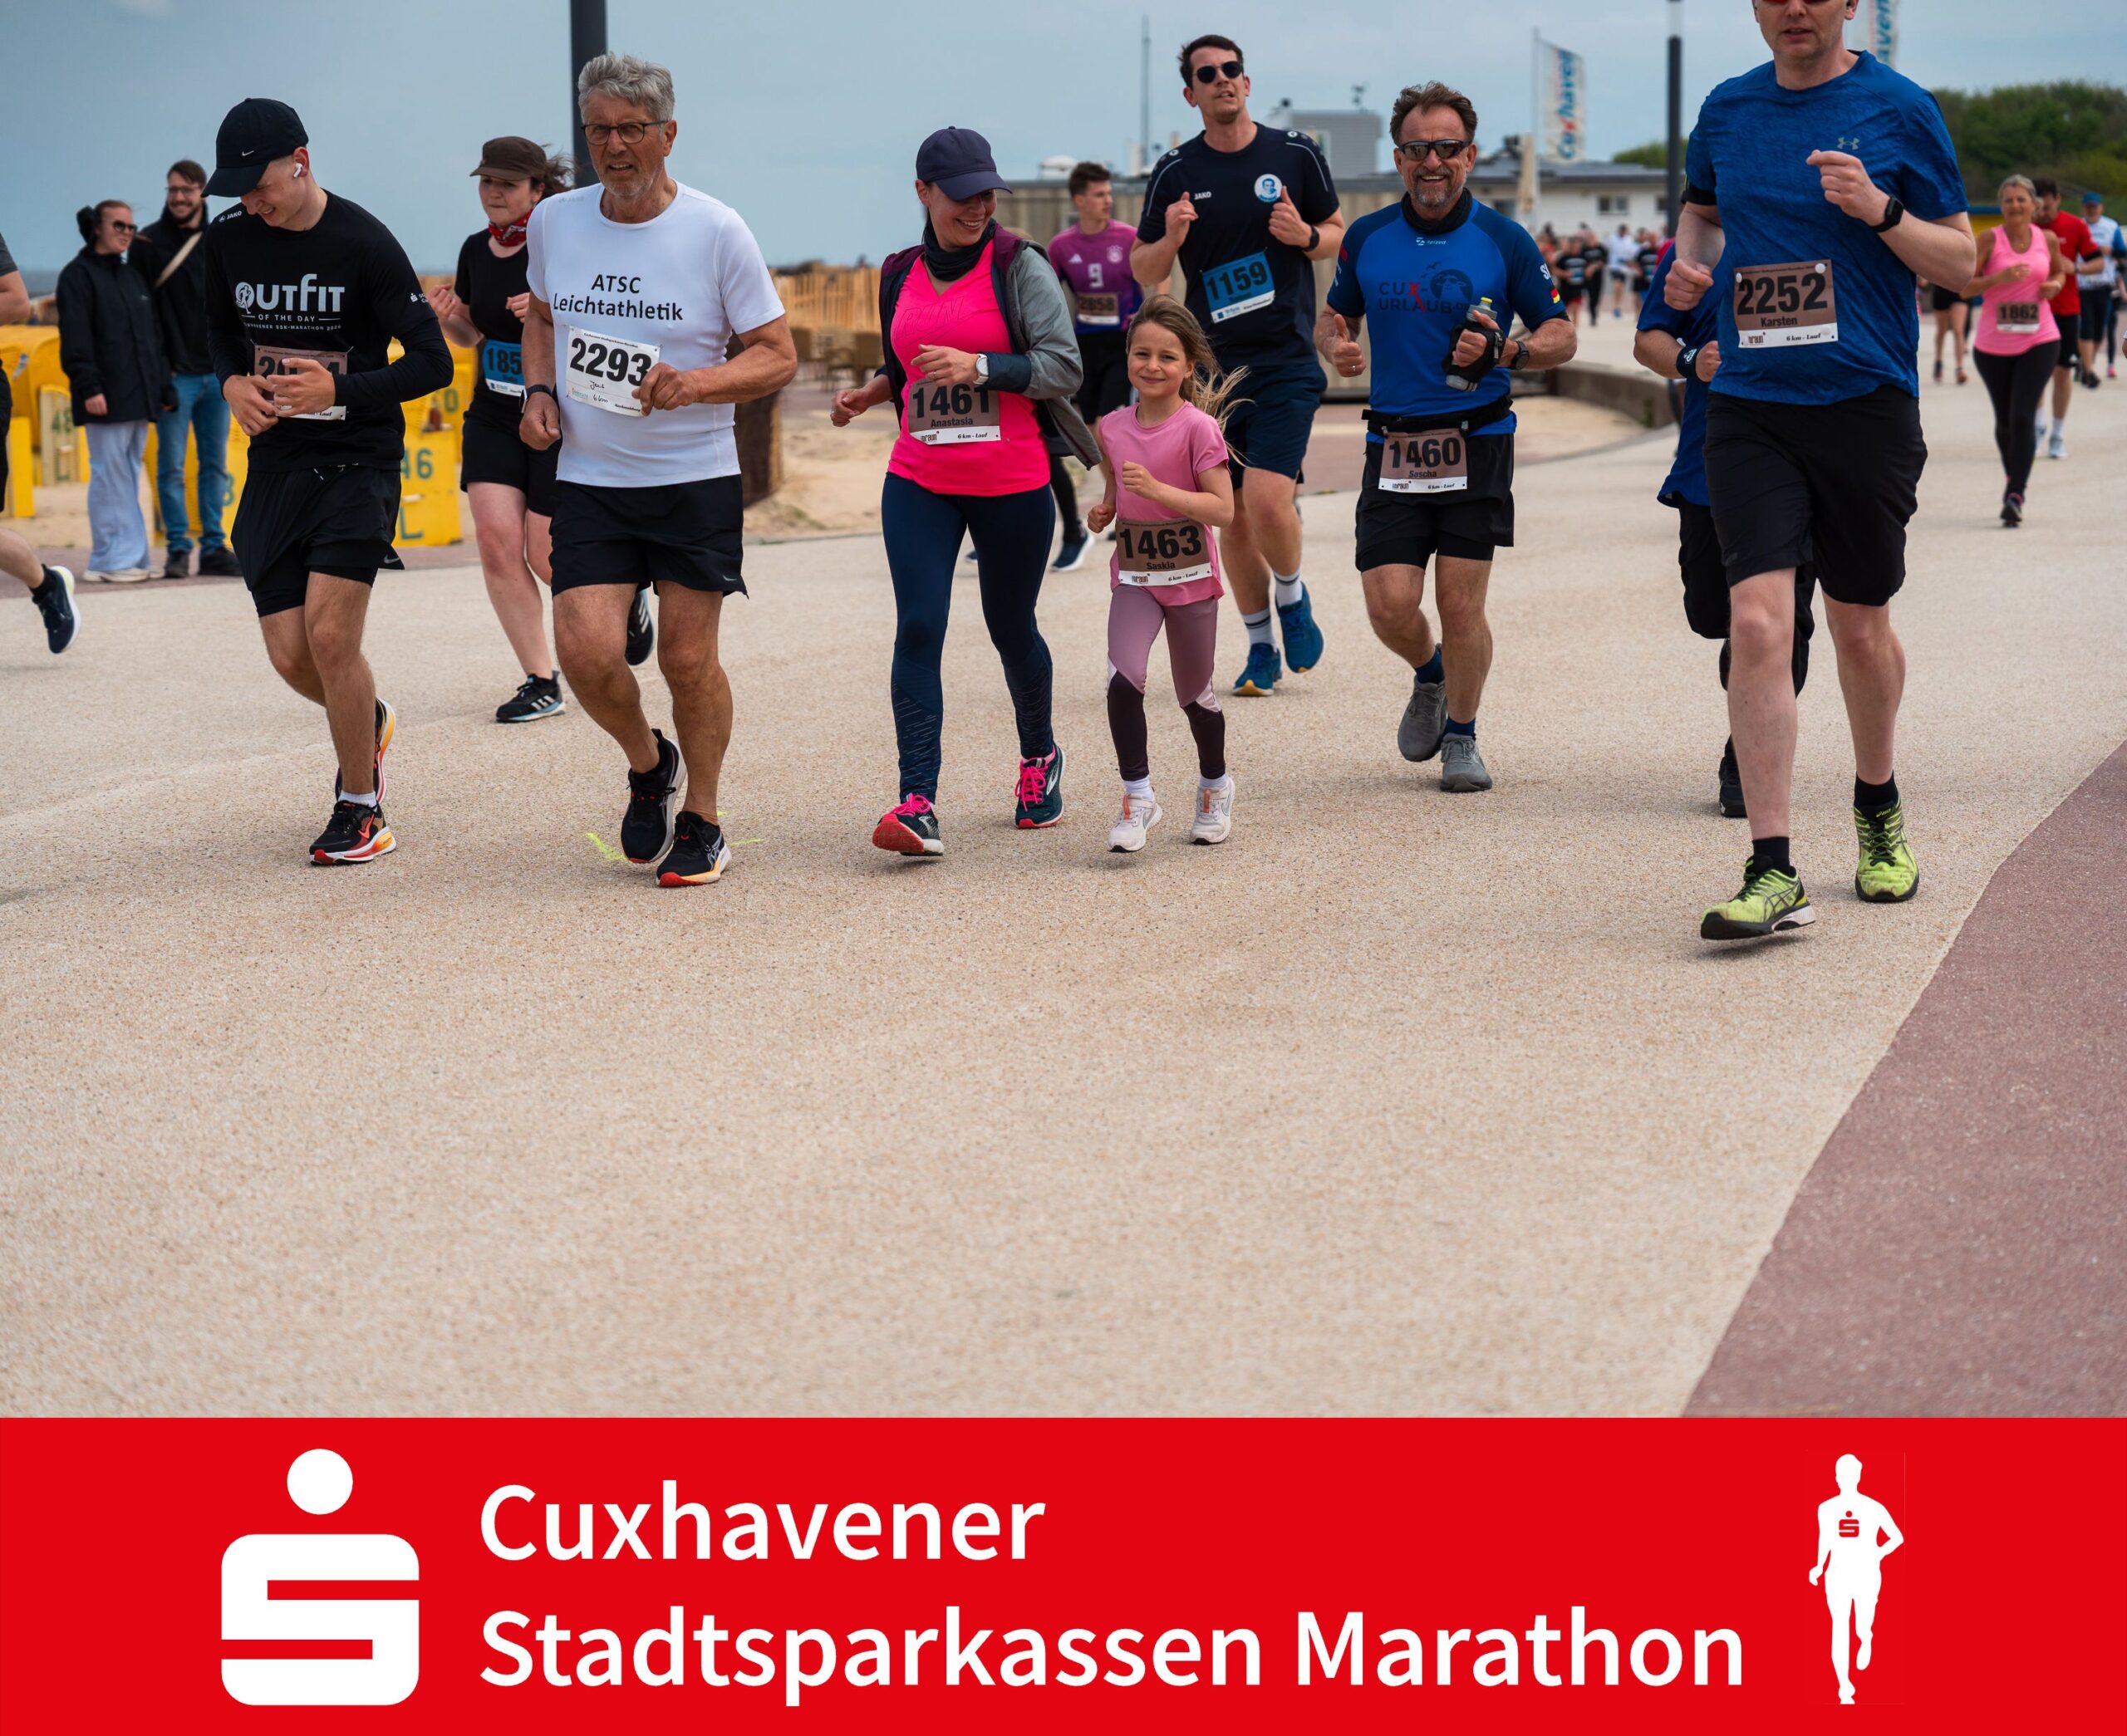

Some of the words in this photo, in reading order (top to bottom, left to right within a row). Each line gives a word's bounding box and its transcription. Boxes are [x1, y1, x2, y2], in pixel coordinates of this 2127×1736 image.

[1195, 191, 1211, 200] JAKO
[227, 210, 243, 220] JAKO
[591, 274, 641, 294] ATSC
[1088, 262, 1104, 288] 9
[1207, 261, 1268, 301] 1159
[553, 292, 684, 321] Leichtathletik
[1737, 272, 1828, 315] 2252
[1761, 316, 1798, 327] Karsten
[570, 337, 651, 387] 2293
[913, 383, 990, 418] 1461
[931, 417, 974, 428] Anastasia
[1389, 437, 1461, 468] 1460
[1409, 470, 1437, 478] Sascha
[398, 505, 425, 540] L
[1120, 525, 1202, 559] 1463
[1147, 562, 1176, 571] Saskia
